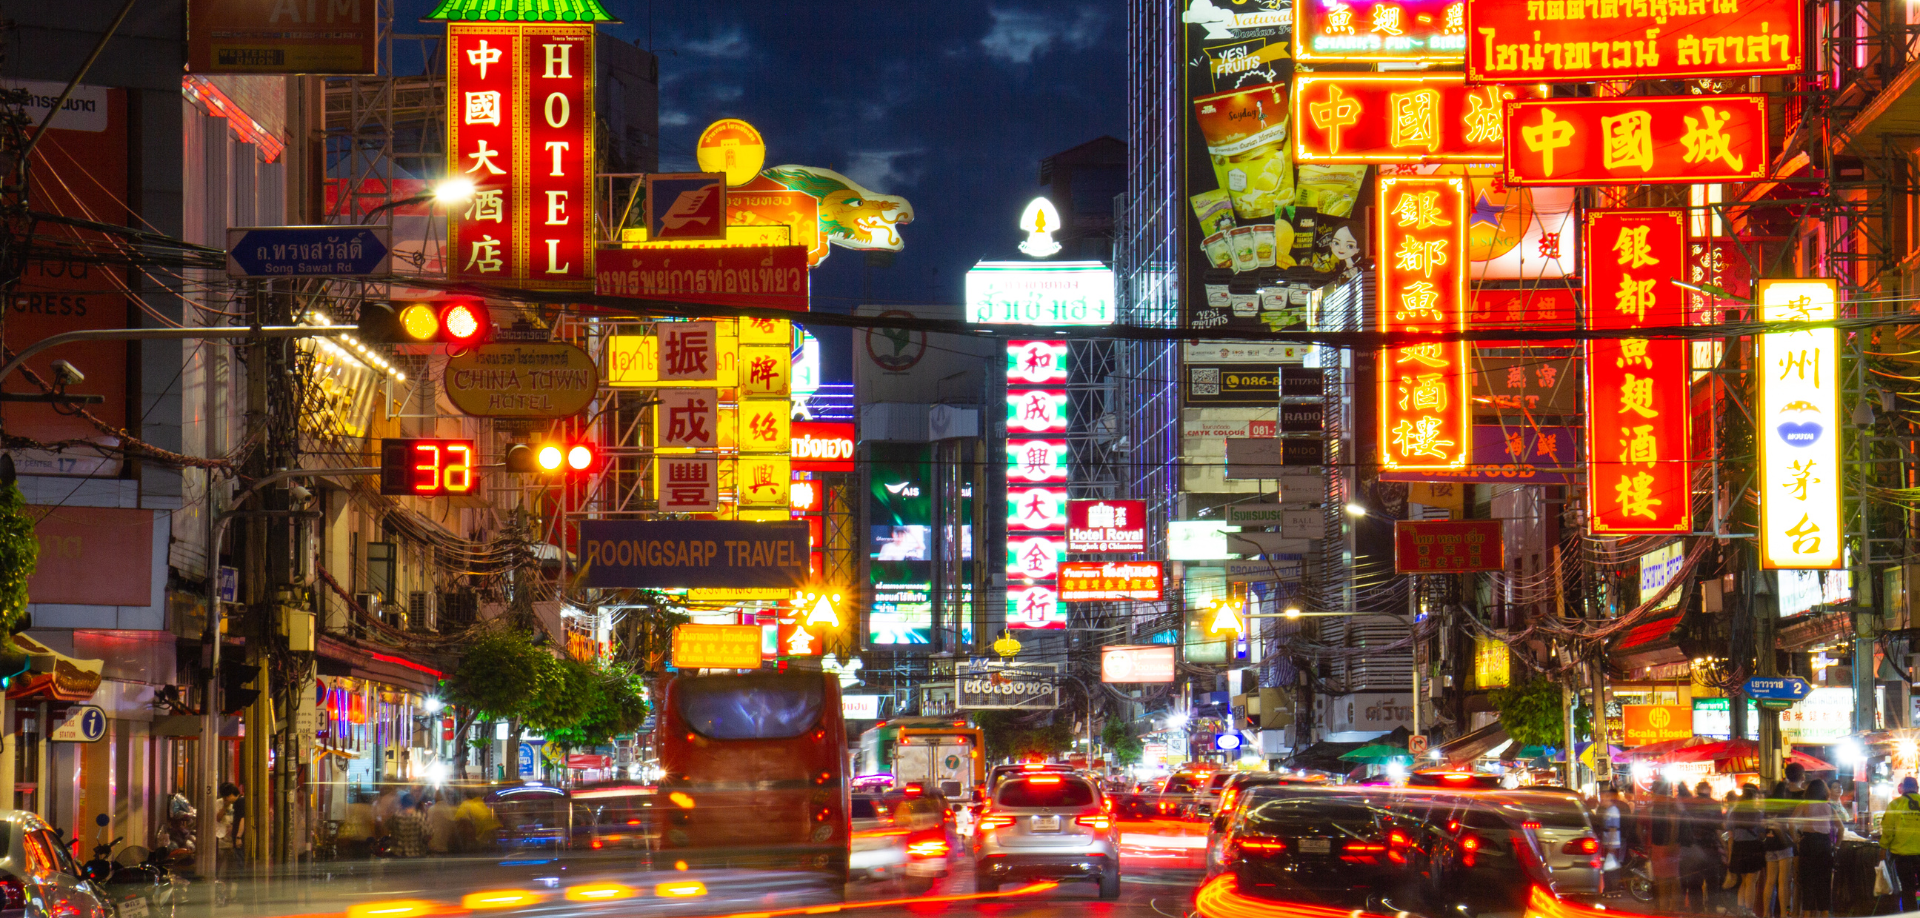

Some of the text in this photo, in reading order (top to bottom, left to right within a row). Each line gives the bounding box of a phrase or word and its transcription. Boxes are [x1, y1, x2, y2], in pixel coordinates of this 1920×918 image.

[268, 0, 360, 23] ATM
[1227, 11, 1293, 27] Natural
[1315, 35, 1381, 49] SHARK'S
[1477, 22, 1791, 71] ไชน่าทาวน์ สกาล่า
[236, 57, 275, 65] UNION
[1218, 45, 1248, 64] YES!
[1217, 55, 1261, 79] FRUITS
[1310, 84, 1513, 155] 中國城
[1521, 105, 1744, 177] 中國城
[464, 39, 507, 274] 中國大酒店
[541, 44, 573, 274] HOTEL
[1480, 236, 1514, 247] SING
[265, 263, 354, 275] Song Sawat Rd.
[1391, 190, 1455, 460] 銀都魚翅酒樓
[454, 367, 590, 392] CHINA TOWN
[1612, 225, 1662, 521] 銀都魚翅酒樓
[1283, 378, 1321, 386] CITIZEN
[488, 393, 554, 411] HOTEL
[665, 331, 710, 506] 振成豐
[1284, 411, 1321, 421] RADO
[1288, 447, 1317, 455] MIDO
[57, 457, 77, 473] 17
[902, 487, 920, 497] AIS
[1022, 346, 1052, 622] 和成興大金行
[1069, 528, 1144, 542] Hotel Royal
[586, 539, 802, 567] ROONGSARP TRAVEL
[1070, 543, 1099, 552] Bangkok
[1418, 556, 1482, 568] 批发干果
[1230, 565, 1276, 577] BROADWAY
[1751, 680, 1802, 694] เยาวราช 2
[59, 731, 76, 739] STATION
[1627, 728, 1693, 738] Scala Hostel
[948, 756, 957, 769] 7
